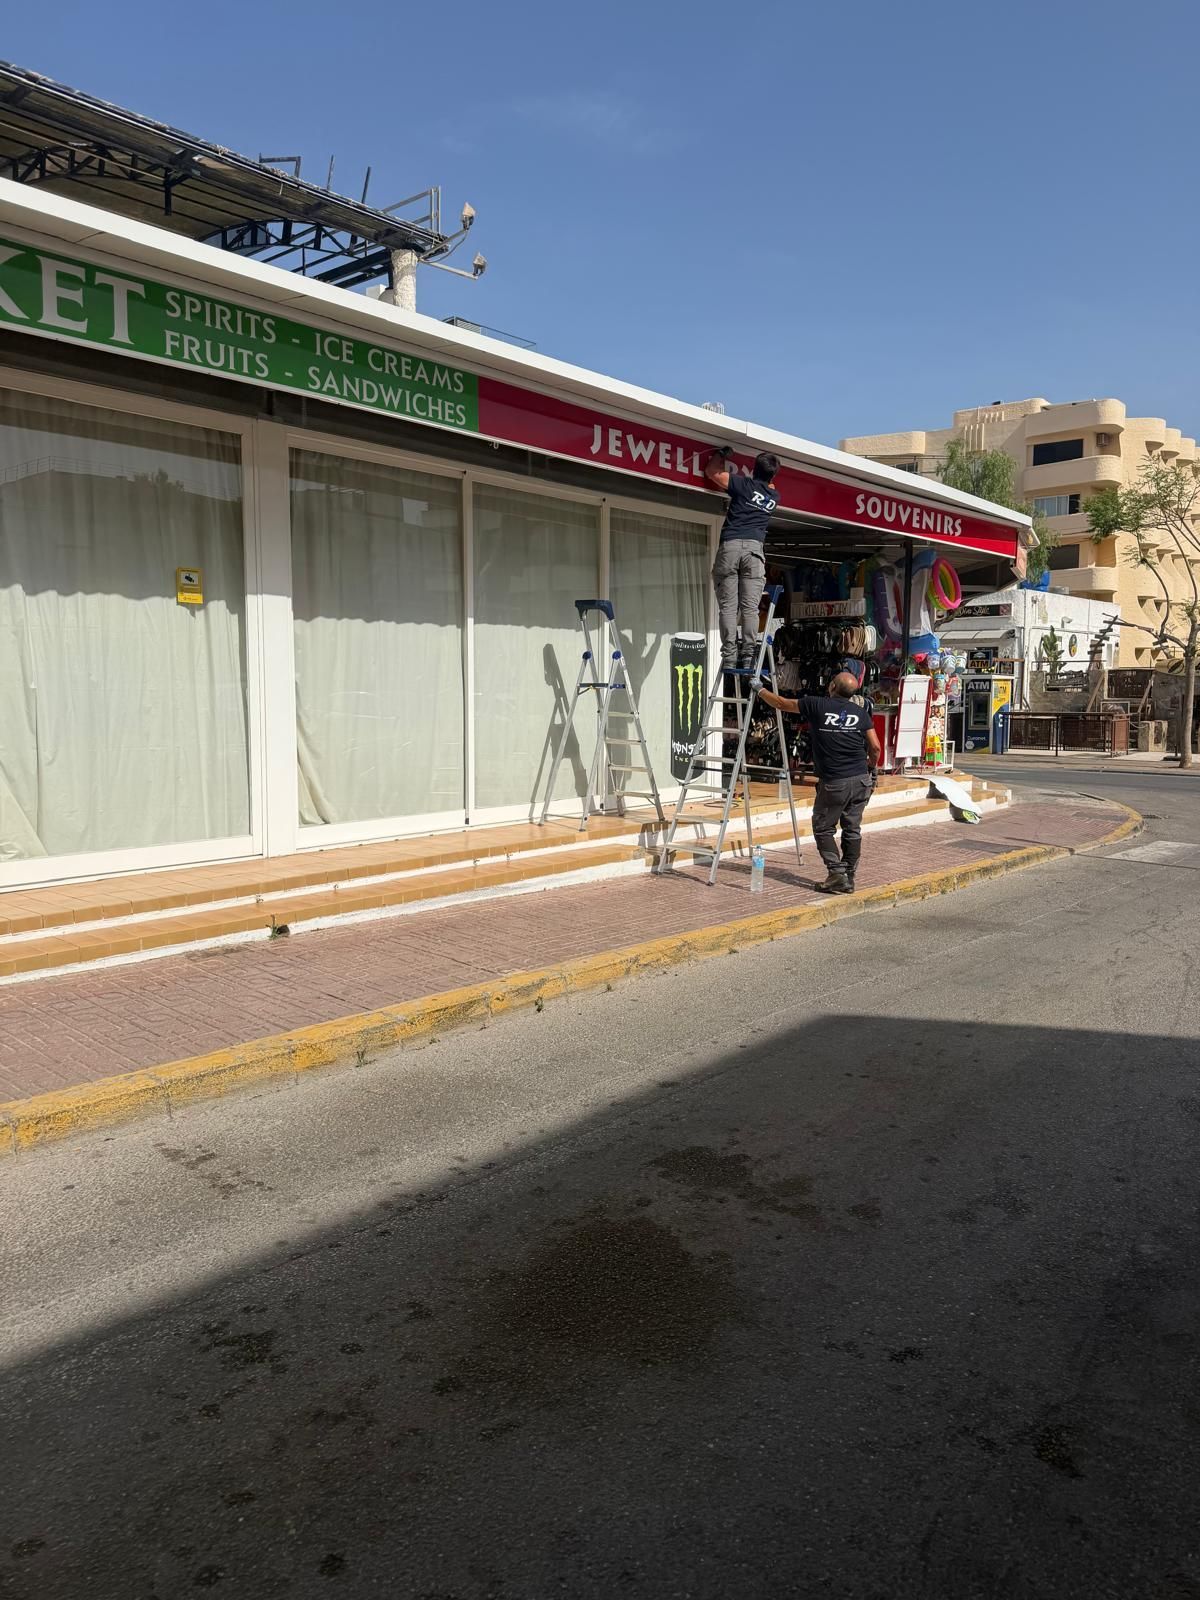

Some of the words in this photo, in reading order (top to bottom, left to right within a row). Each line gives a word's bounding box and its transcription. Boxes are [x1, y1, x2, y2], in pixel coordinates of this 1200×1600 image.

[165, 291, 277, 344] SPIRITS
[315, 333, 354, 365] ICE
[367, 348, 464, 393] CREAMS
[164, 329, 269, 378] FRUITS
[307, 366, 466, 426] SANDWICHES
[855, 493, 962, 537] SOUVENIRS
[967, 681, 990, 690] ATM
[969, 660, 989, 668] ATM
